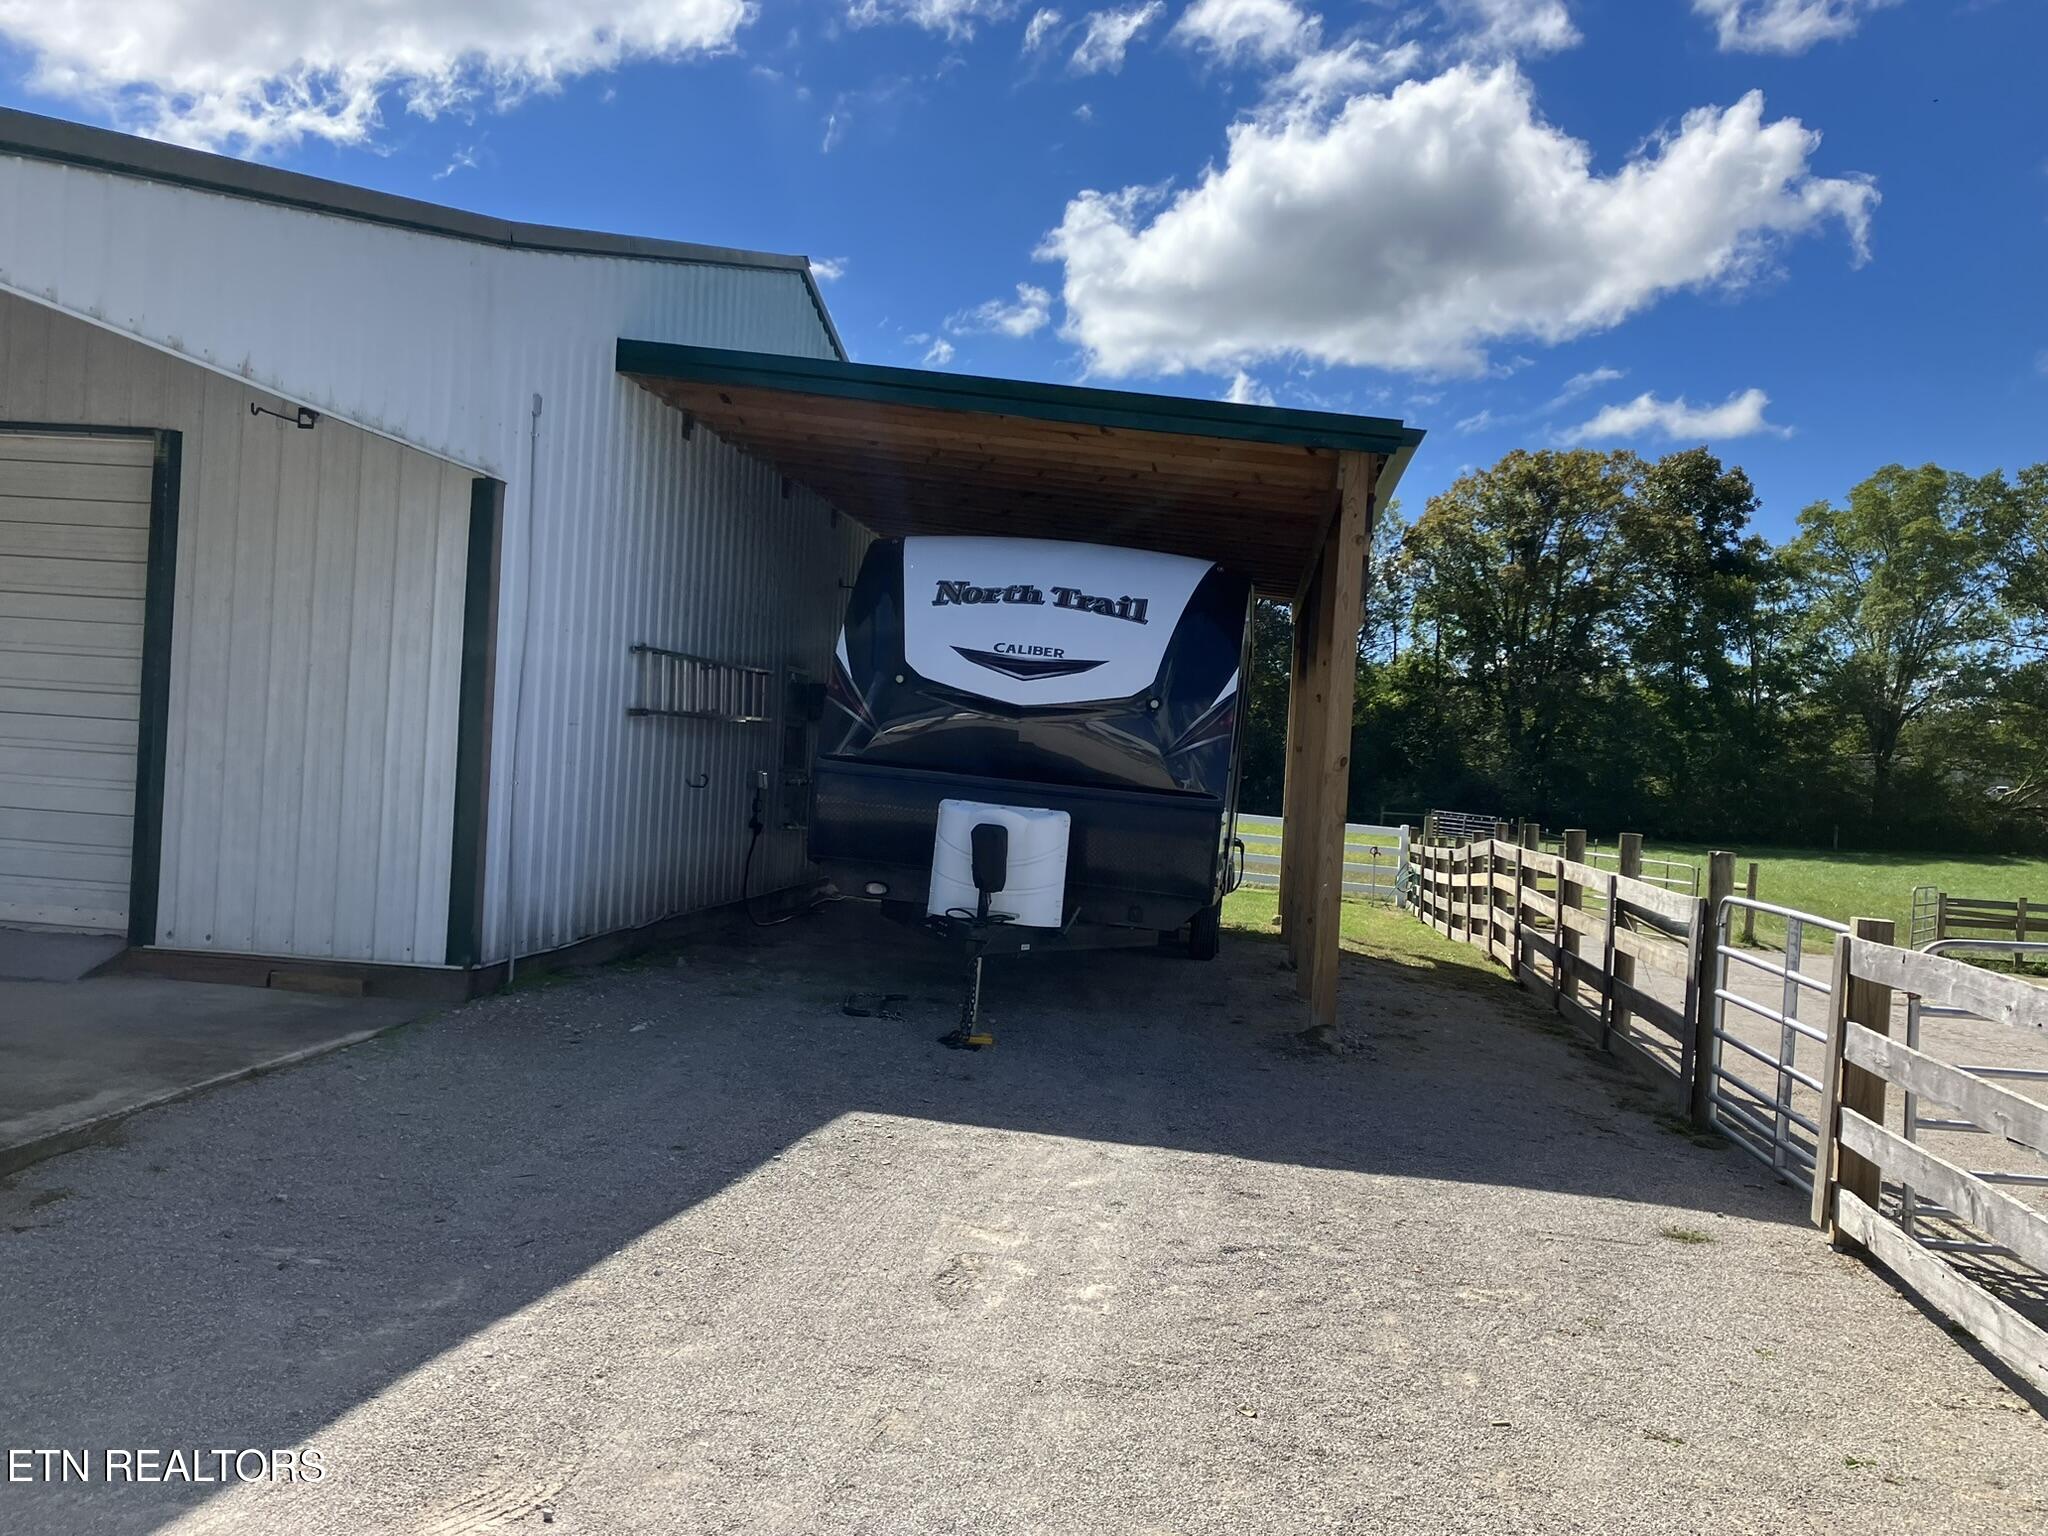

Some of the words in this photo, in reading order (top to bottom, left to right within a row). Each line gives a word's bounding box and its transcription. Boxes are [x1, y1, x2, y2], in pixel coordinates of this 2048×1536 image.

[931, 580, 1045, 606] North
[1050, 586, 1149, 625] Trail
[993, 642, 1065, 658] CALIBER
